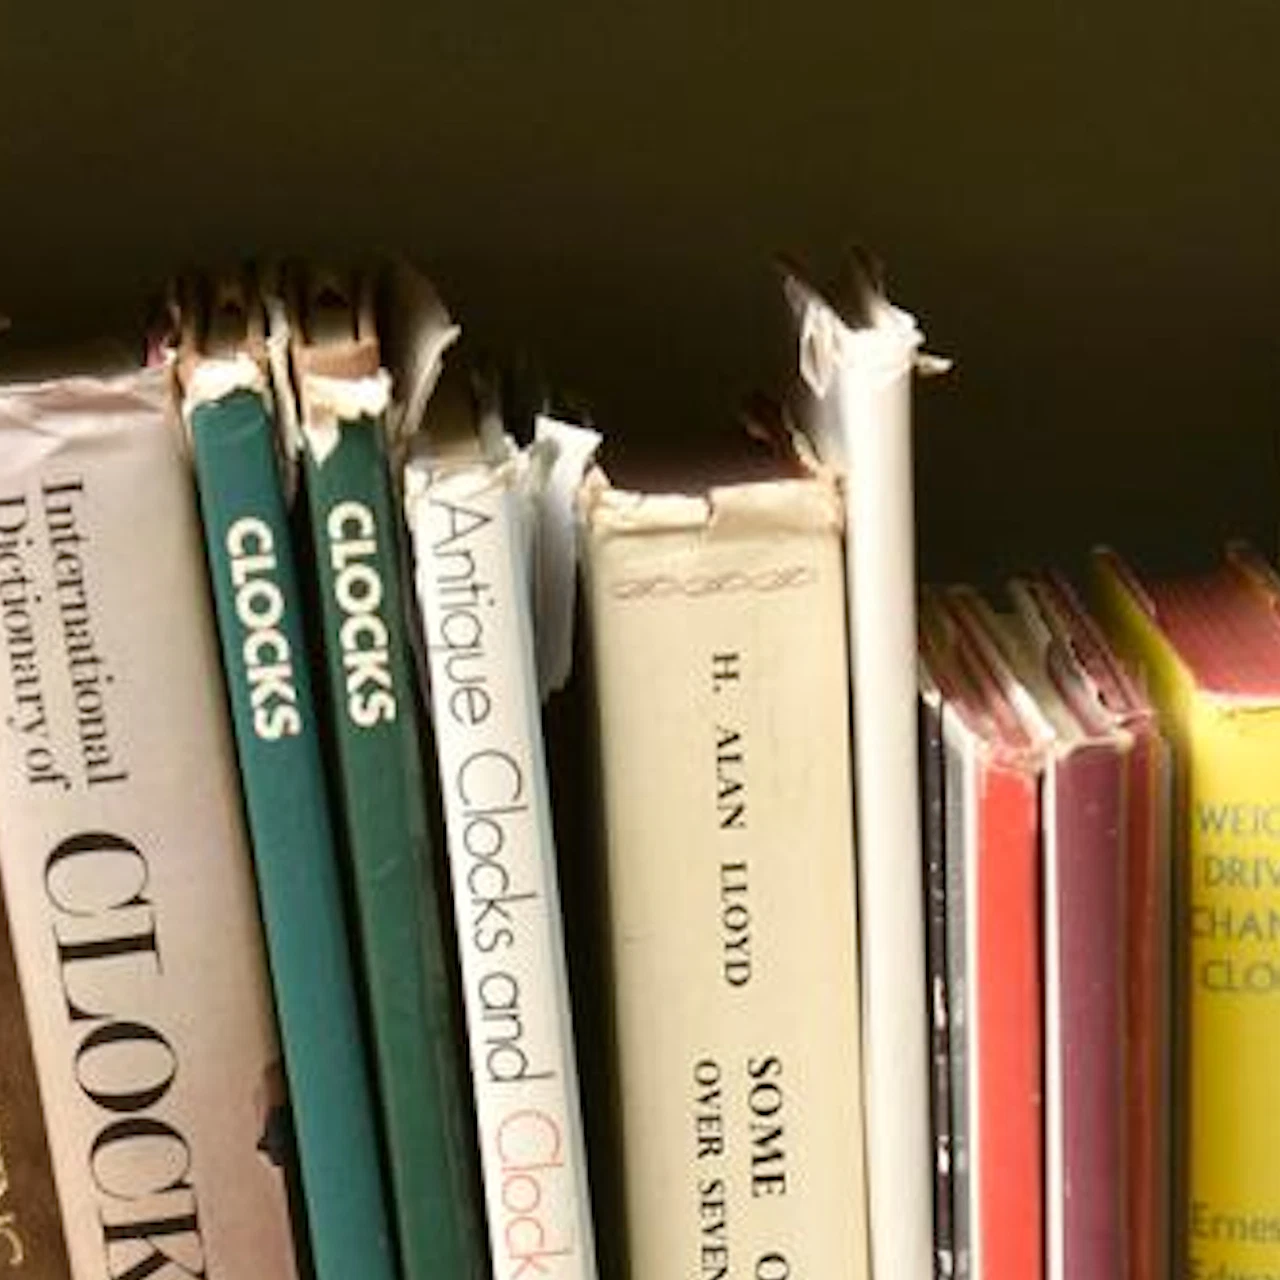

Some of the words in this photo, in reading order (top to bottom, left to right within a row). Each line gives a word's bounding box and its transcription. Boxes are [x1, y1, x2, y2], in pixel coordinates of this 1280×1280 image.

[40, 476, 130, 789] International
[226, 517, 302, 742] CLOCKS
[327, 501, 396, 728] CLOCKS
[429, 499, 497, 728] Antique
[711, 650, 741, 696] H.
[25, 747, 72, 791] of
[715, 724, 745, 833] ALAN
[456, 747, 539, 955] Clocks
[719, 860, 749, 989] LLOYD
[478, 971, 558, 1085] and
[692, 1059, 723, 1160] OVER
[746, 1054, 786, 1199] SOME
[496, 1106, 575, 1280] Clock
